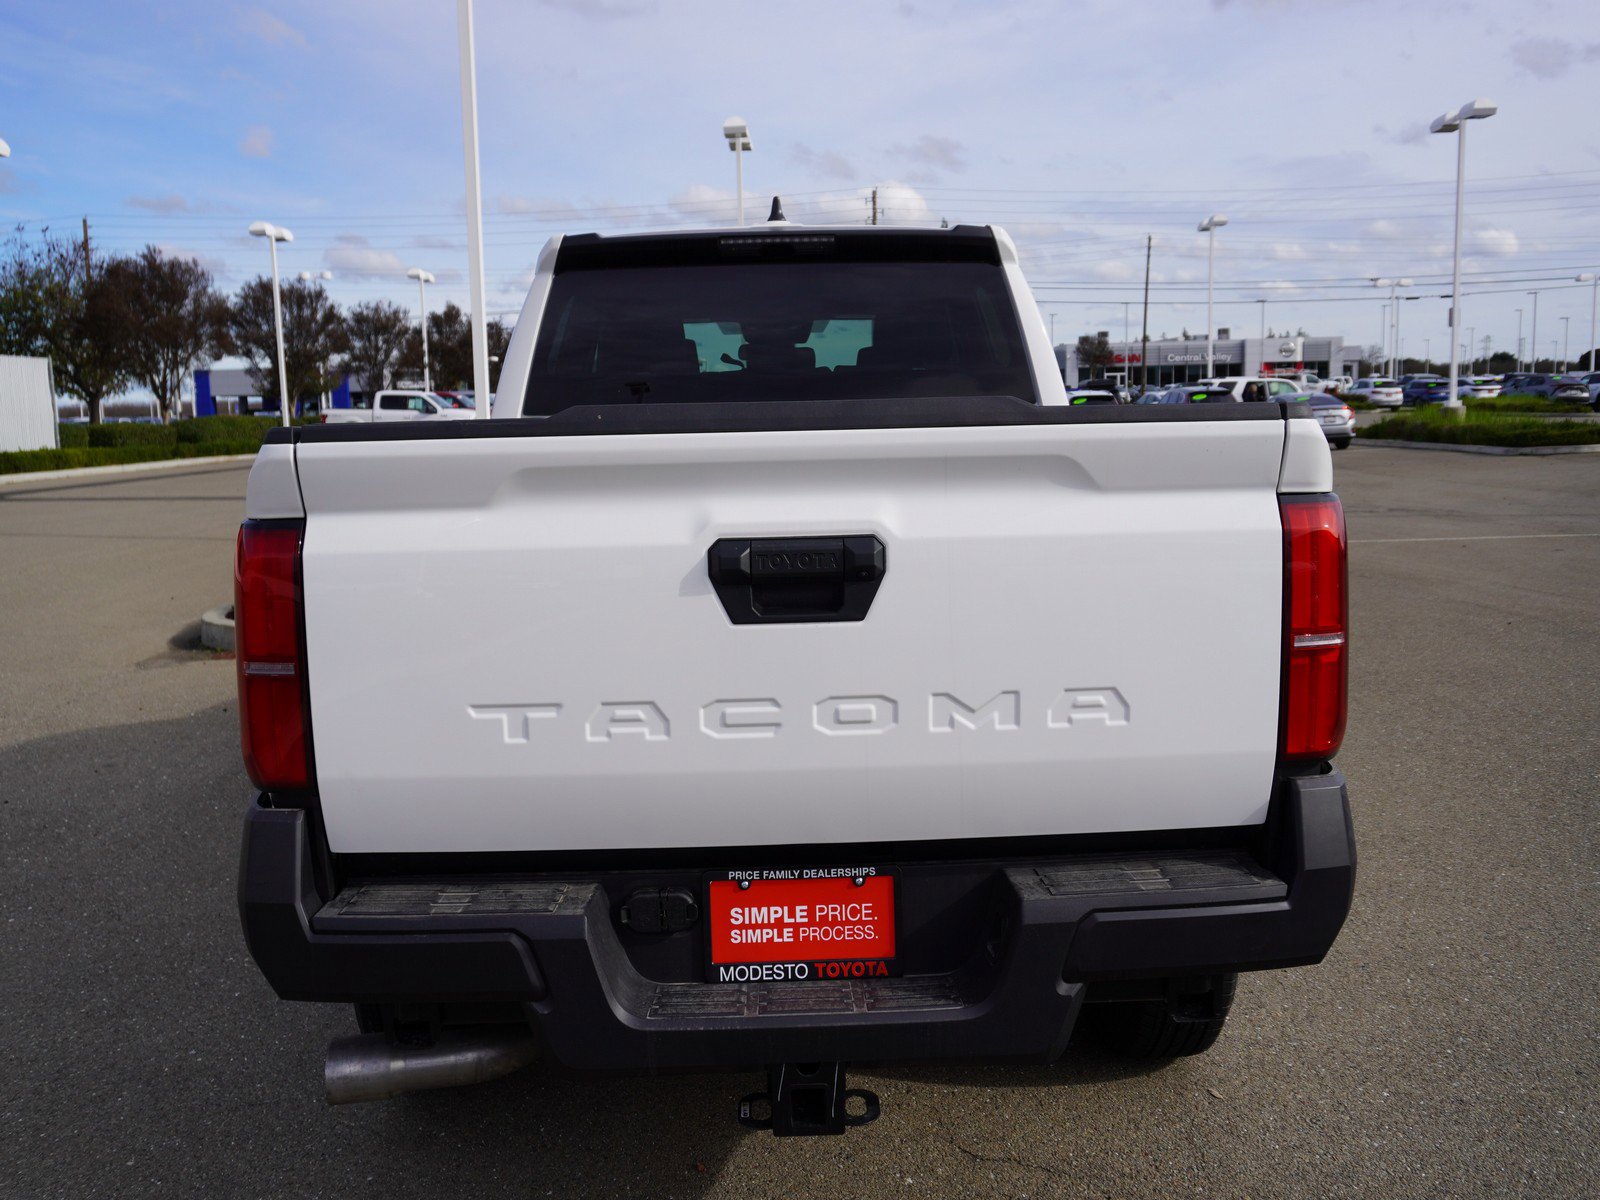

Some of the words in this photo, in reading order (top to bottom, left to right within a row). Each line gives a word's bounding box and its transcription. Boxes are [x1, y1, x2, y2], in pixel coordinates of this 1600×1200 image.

[1167, 353, 1202, 362] Central
[754, 552, 839, 570] TOYOTA
[467, 686, 1131, 744] TACOMA
[728, 871, 760, 880] PRICE
[763, 870, 800, 879] FAMILY
[803, 867, 876, 879] DEALERSHIPS
[730, 906, 808, 925] SIMPLE
[815, 904, 878, 922] PRICE.
[730, 928, 794, 944] SIMPLE
[799, 925, 879, 942] PROCESS.
[719, 963, 809, 982] MODESTO
[814, 961, 888, 978] TOYOTA
